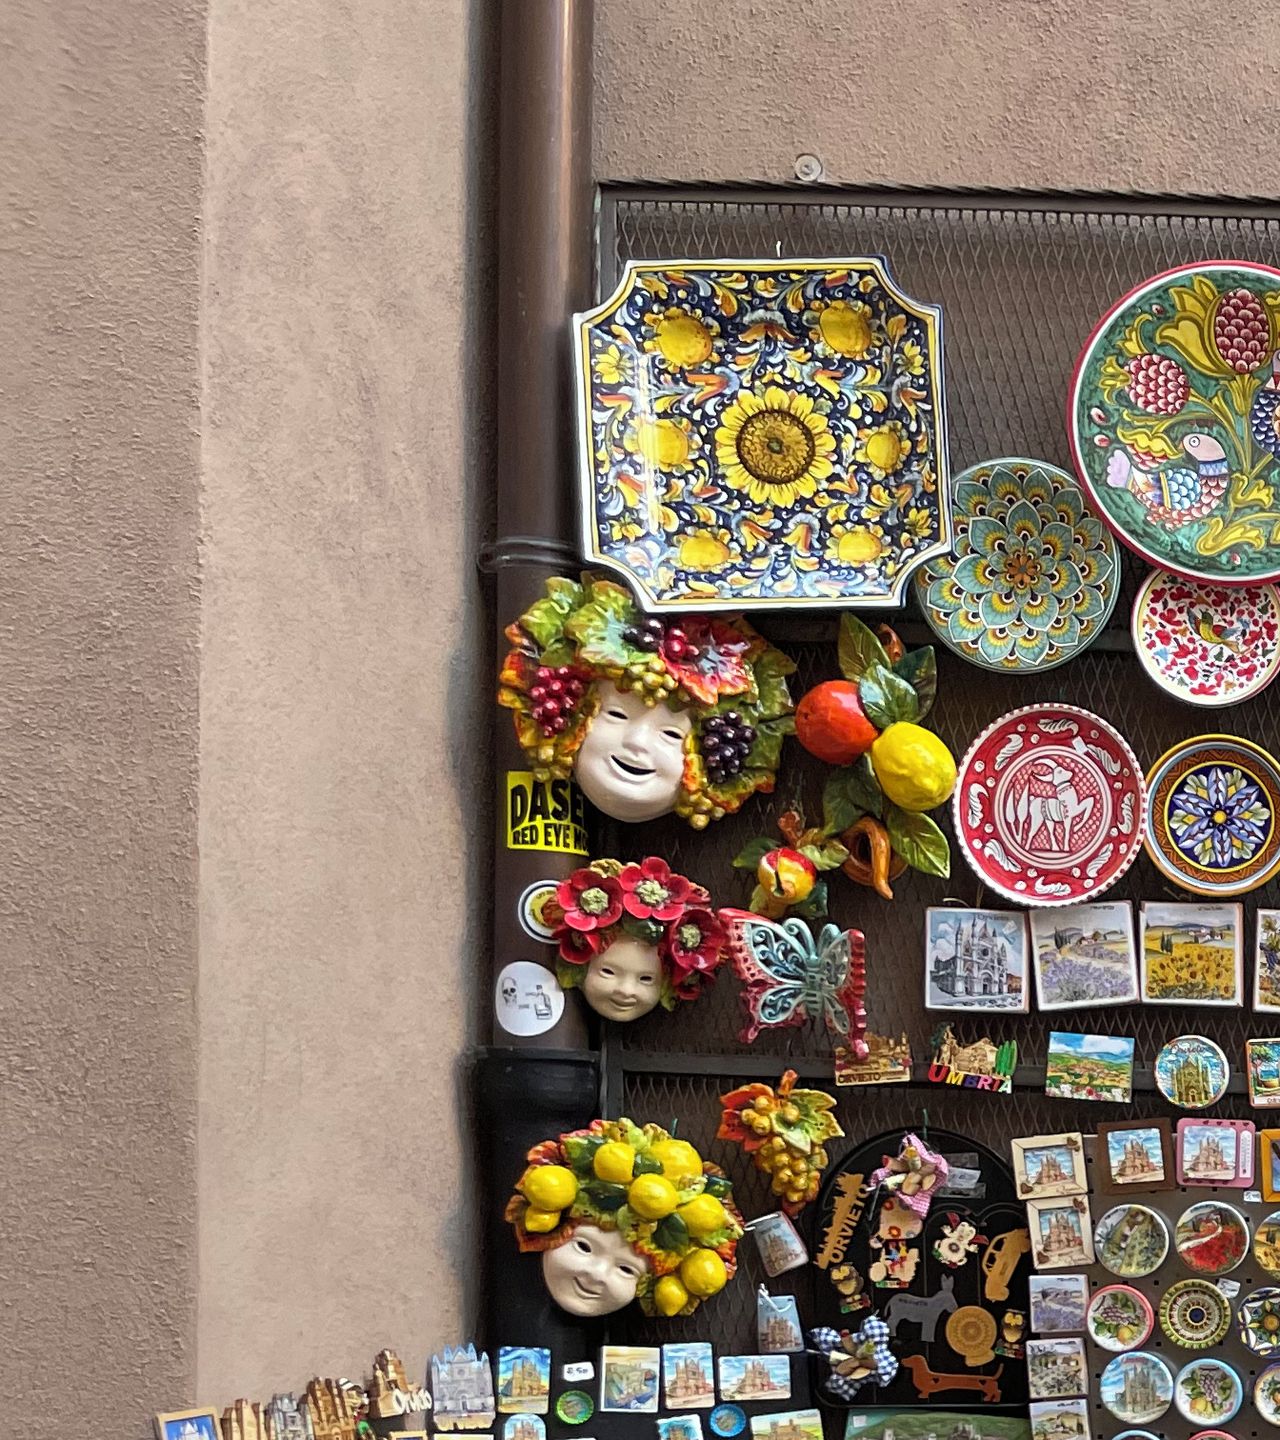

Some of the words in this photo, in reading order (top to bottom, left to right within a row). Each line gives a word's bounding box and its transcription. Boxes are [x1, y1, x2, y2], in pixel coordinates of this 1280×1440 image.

[512, 824, 539, 846] RED
[543, 823, 571, 850] EYE
[928, 1064, 1013, 1095] UMBRIA
[829, 1184, 869, 1264] ORVIETO
